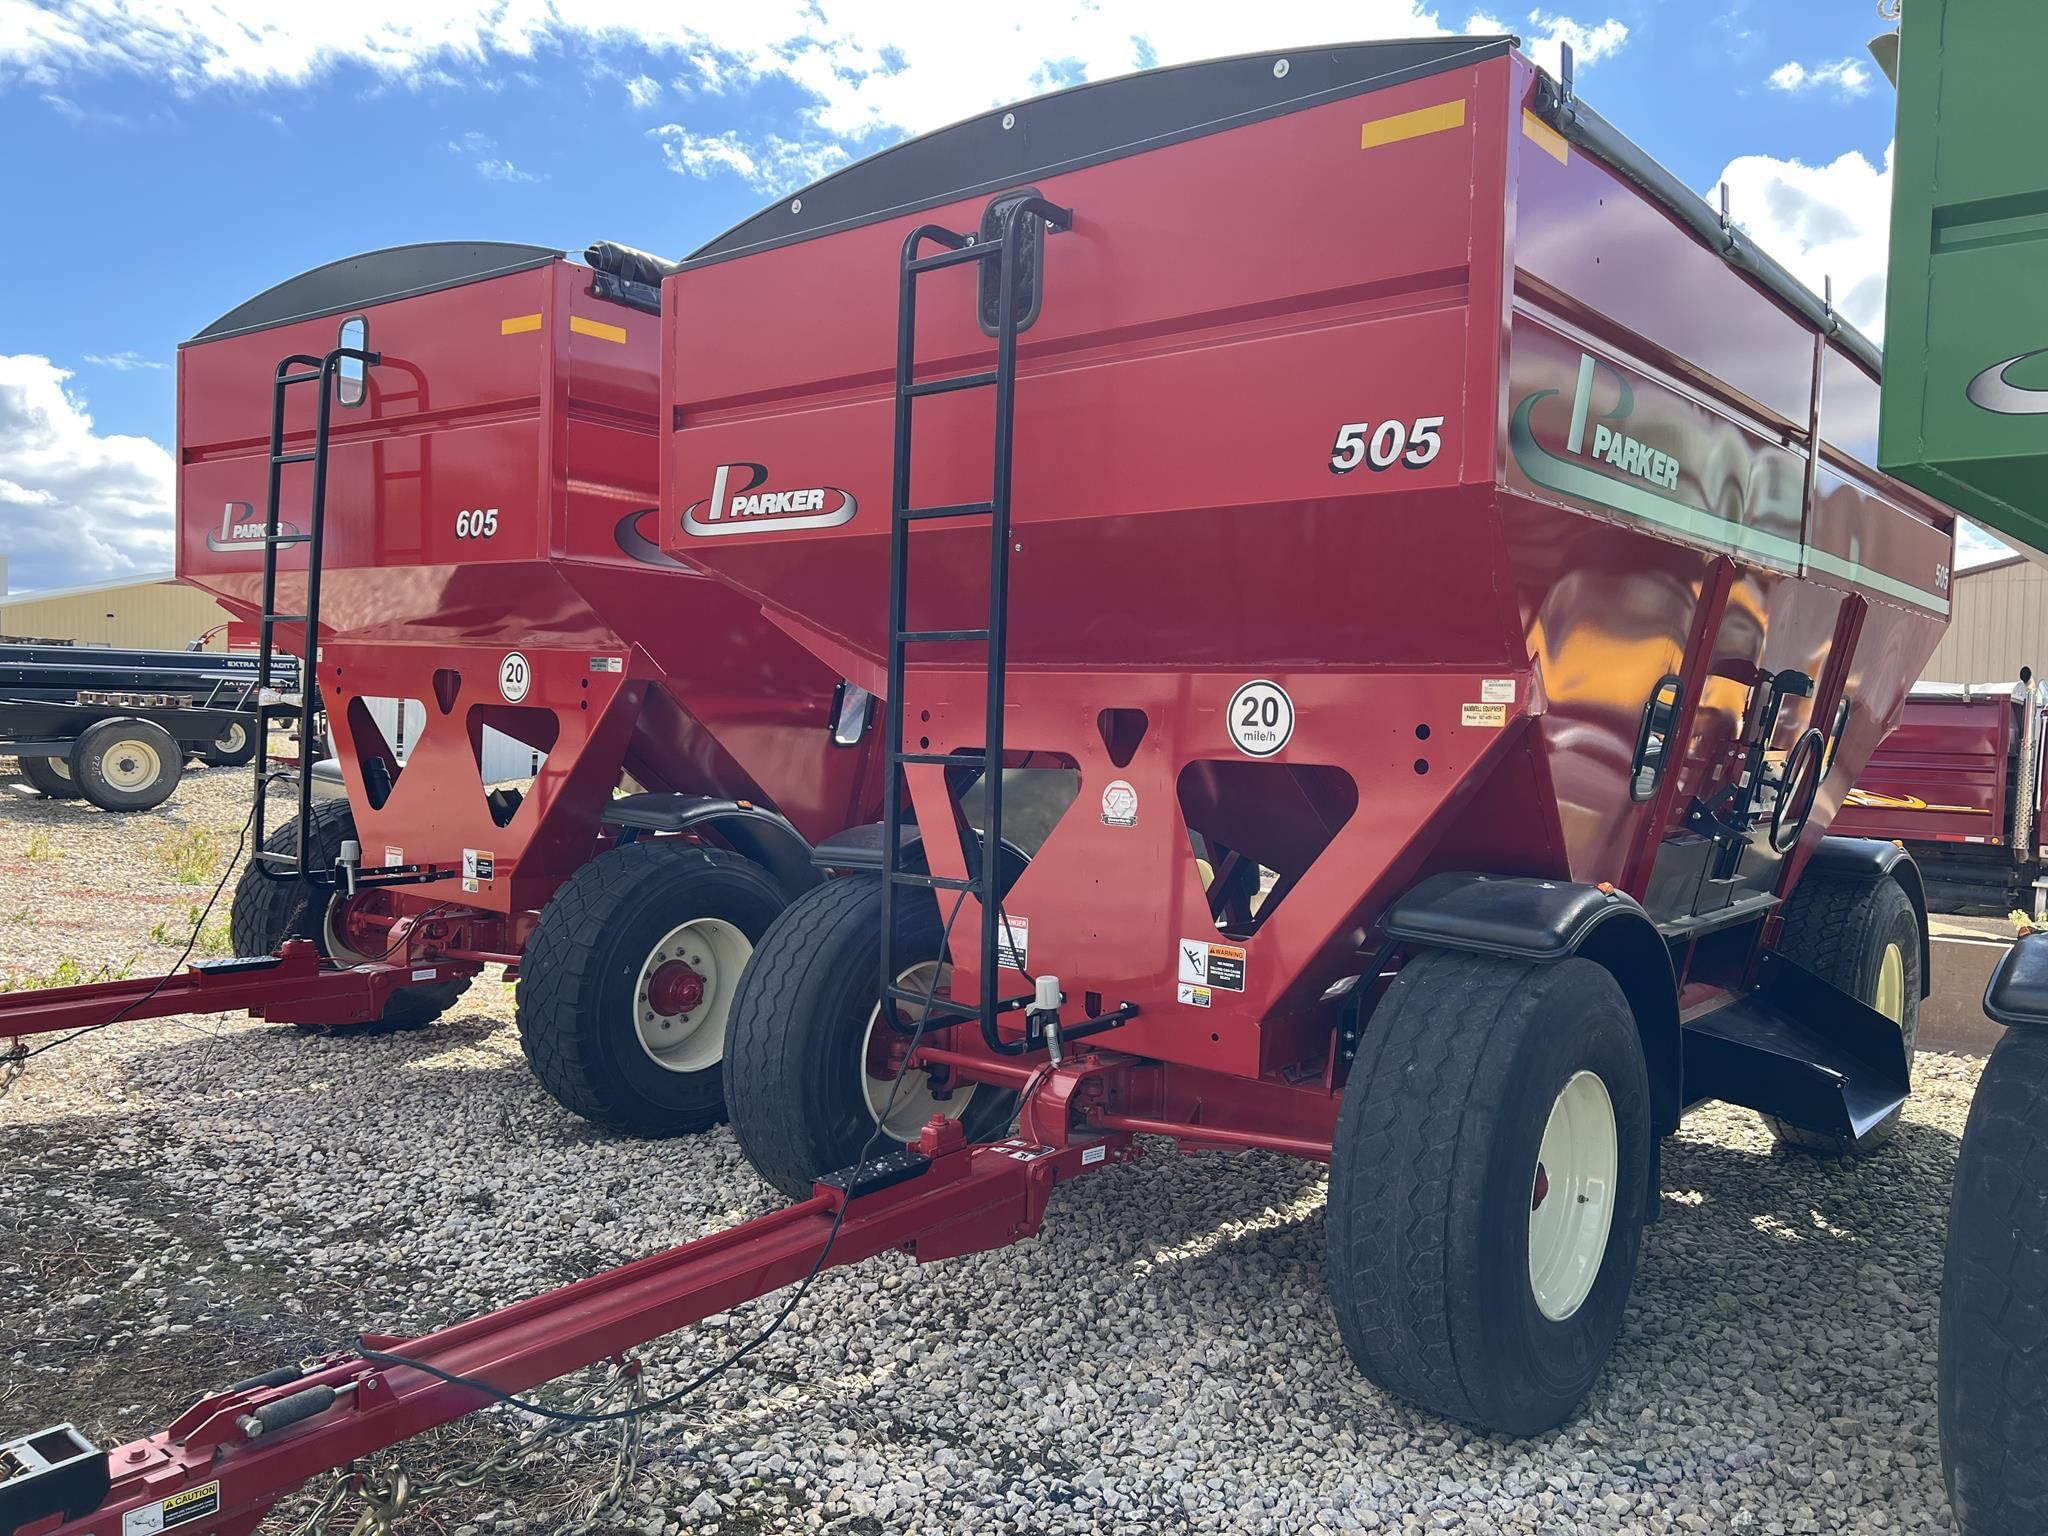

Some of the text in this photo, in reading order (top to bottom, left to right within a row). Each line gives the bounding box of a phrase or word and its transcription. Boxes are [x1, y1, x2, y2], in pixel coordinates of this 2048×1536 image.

[1328, 415, 1446, 475] 505
[1591, 423, 1681, 491] PARKER
[729, 487, 826, 518] PARKER
[232, 521, 284, 539] PARKR
[455, 507, 499, 540] 605
[1934, 562, 1950, 591] 505
[505, 662, 524, 684] 20
[1240, 696, 1280, 728] 20
[1243, 730, 1276, 742] mile/h
[1108, 791, 1132, 810] 75
[1215, 947, 1244, 959] WARNING
[174, 1485, 216, 1506] CAUTION
